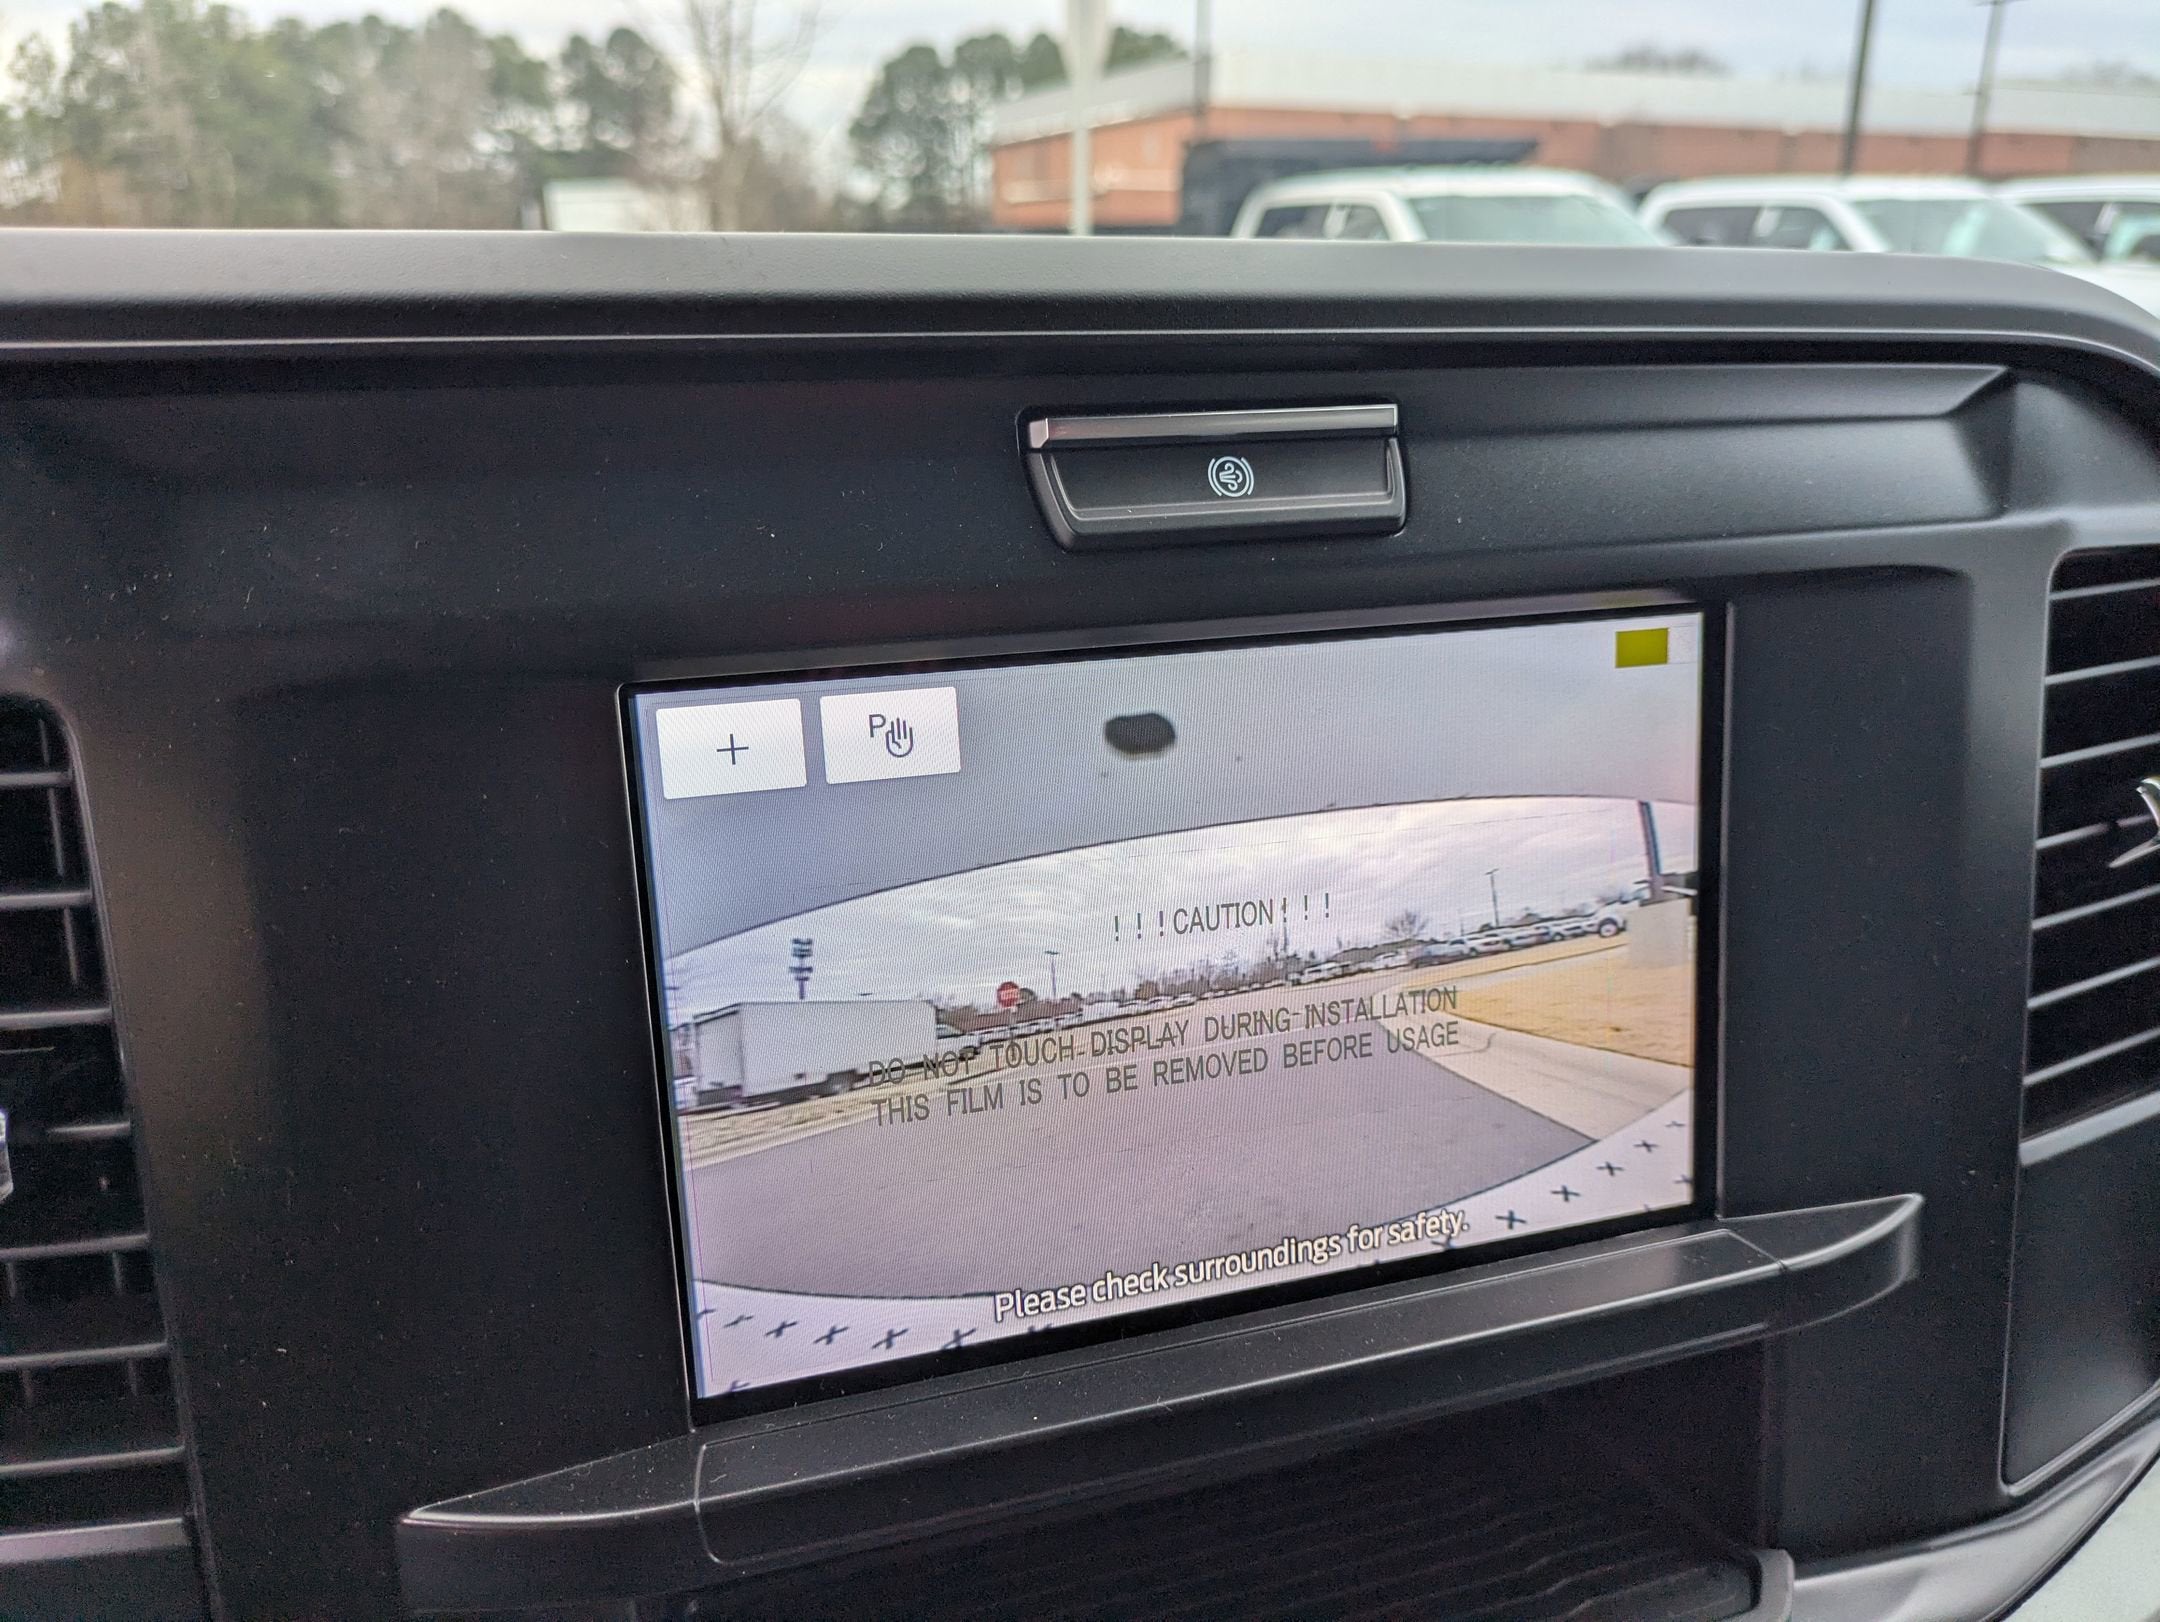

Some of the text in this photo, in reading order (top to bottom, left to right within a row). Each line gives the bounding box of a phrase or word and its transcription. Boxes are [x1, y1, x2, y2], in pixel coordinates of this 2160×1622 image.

[868, 985, 1456, 1087] DO NOT TOUCH DISPLAY DURING INSTALLATION
[871, 1021, 1459, 1126] THIS FILM IS TO BE REMOVED BEFORE USAGE
[994, 1208, 1470, 1323] Please check surroundings for safety.
